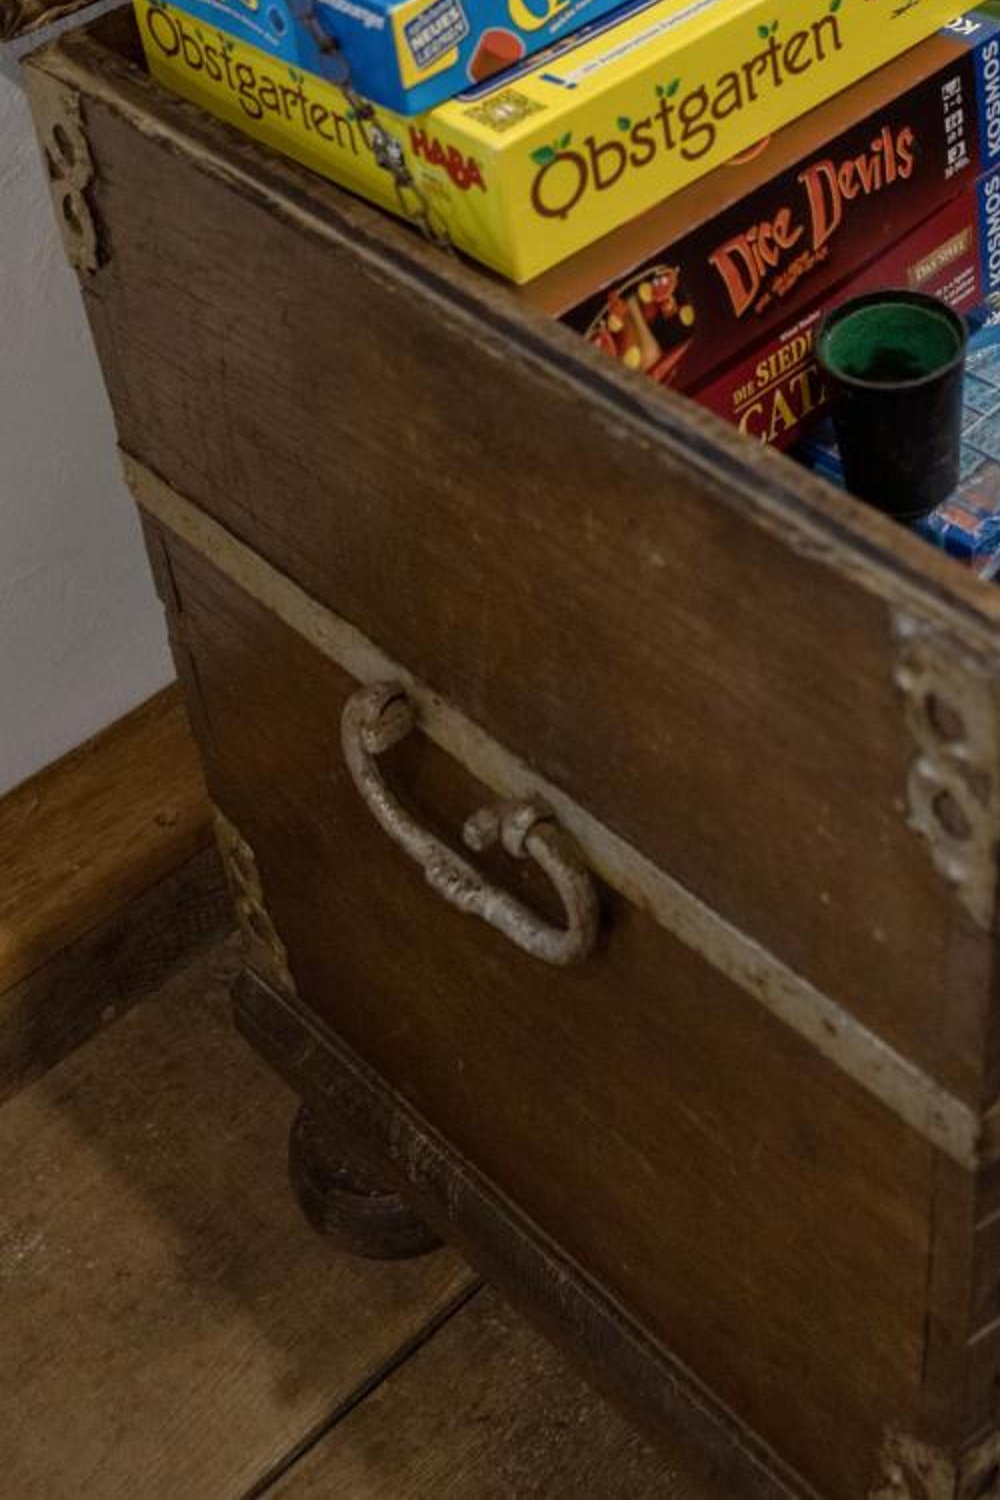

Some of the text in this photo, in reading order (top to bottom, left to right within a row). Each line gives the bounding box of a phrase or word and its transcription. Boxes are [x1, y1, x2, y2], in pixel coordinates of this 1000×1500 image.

[147, 5, 360, 157] Obstgarten
[409, 125, 488, 193] HABA
[531, 14, 844, 220] Obstgarten
[709, 206, 804, 320] Dice
[797, 124, 915, 251] Devils
